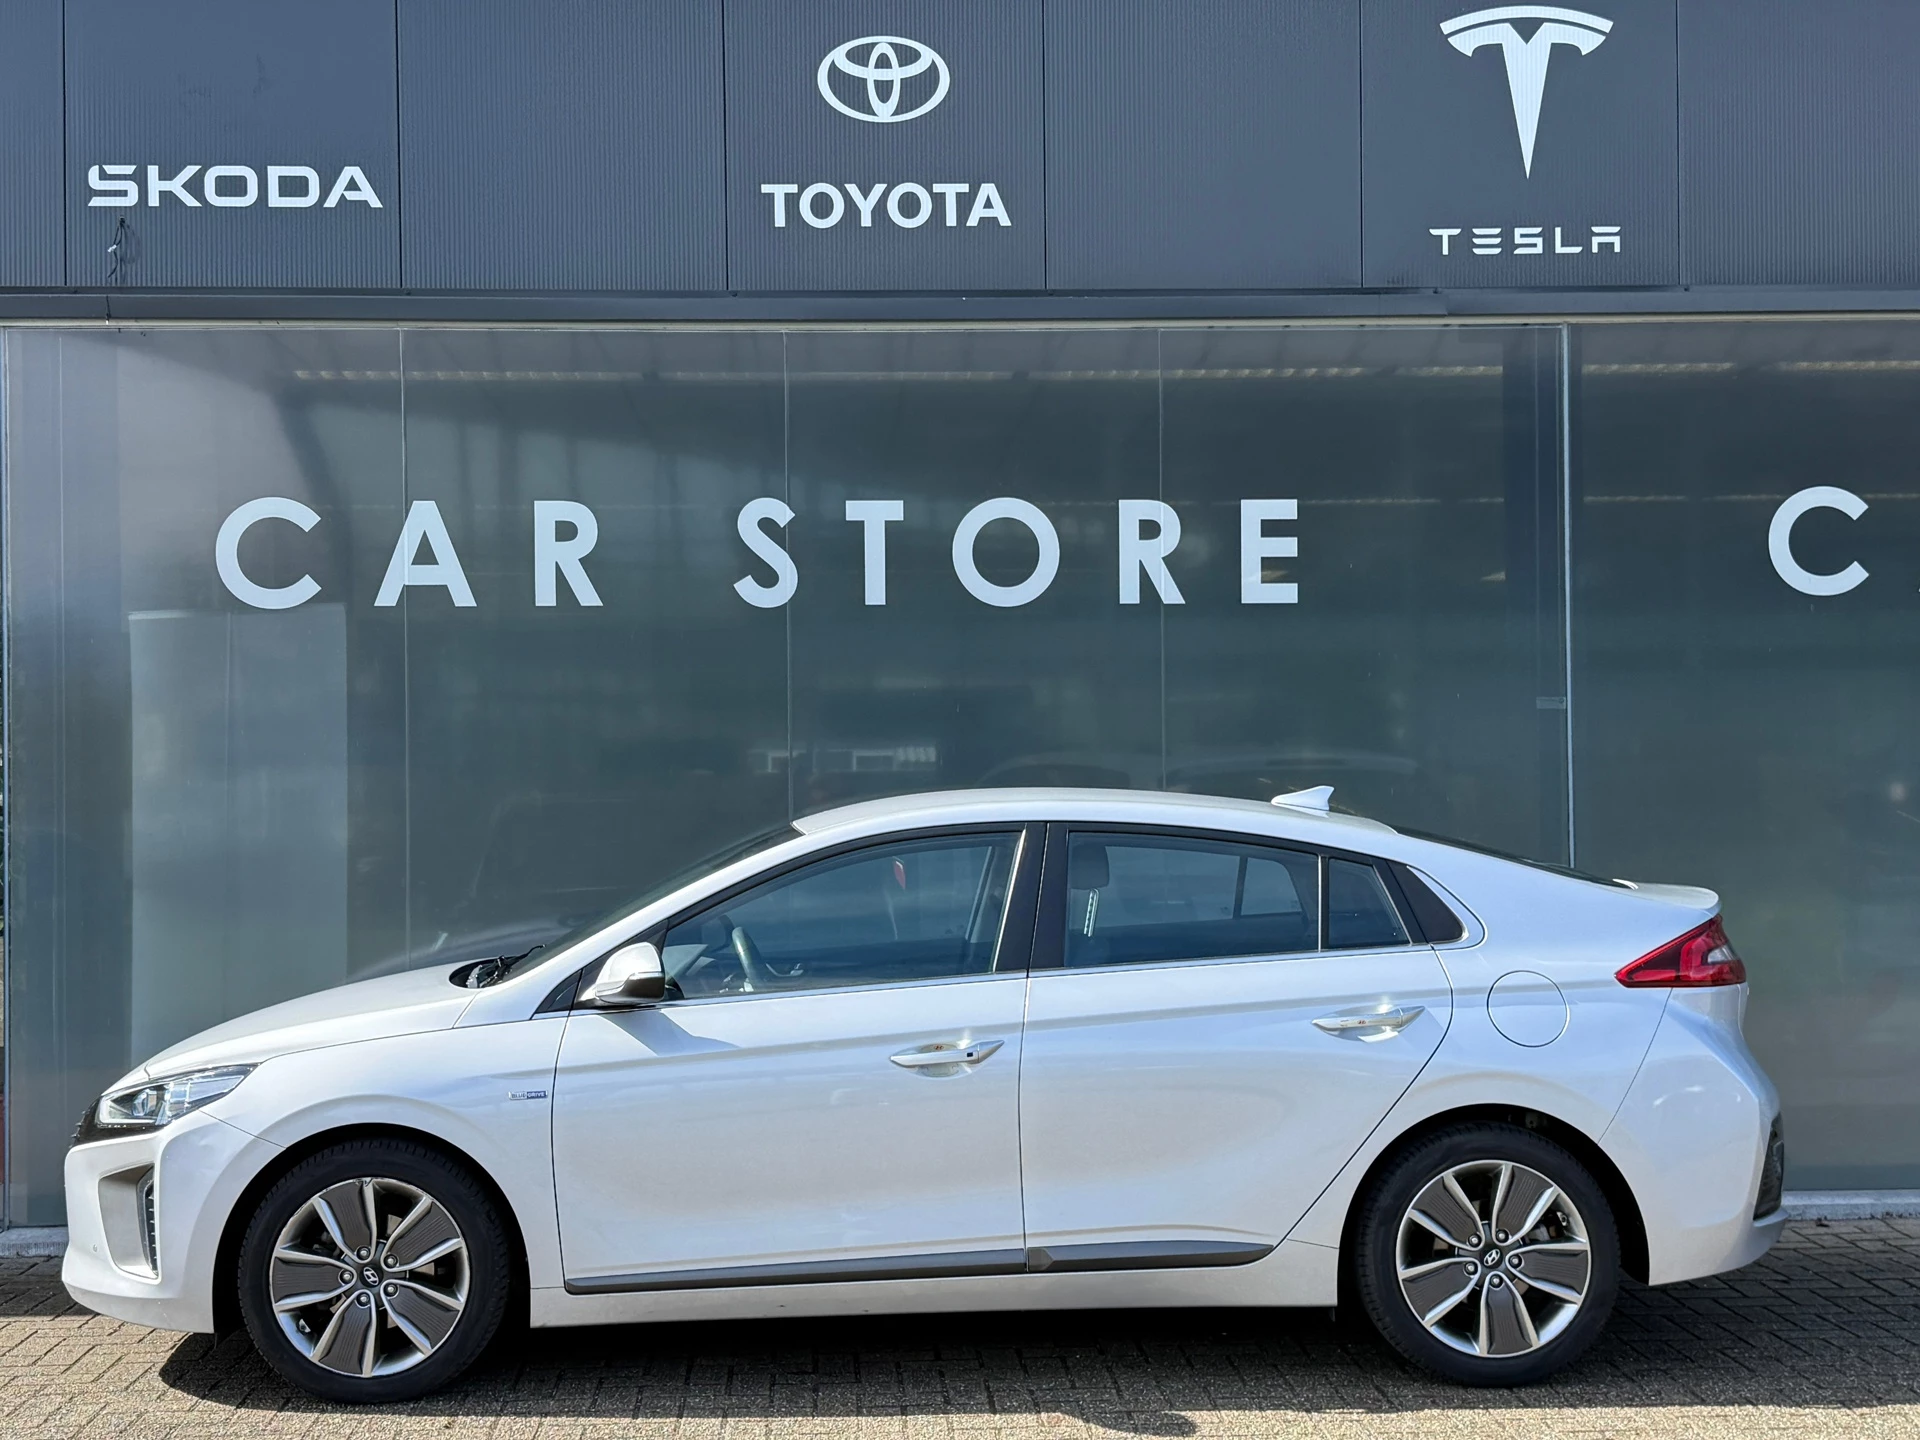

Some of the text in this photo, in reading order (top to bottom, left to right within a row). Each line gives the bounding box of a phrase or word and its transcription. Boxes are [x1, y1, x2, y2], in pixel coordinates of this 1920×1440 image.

[87, 164, 384, 209] SKODA
[760, 182, 1012, 229] TOYOTA
[1428, 226, 1622, 256] TESLA
[215, 496, 1299, 610] CAR STORE
[1768, 486, 1920, 596] C
